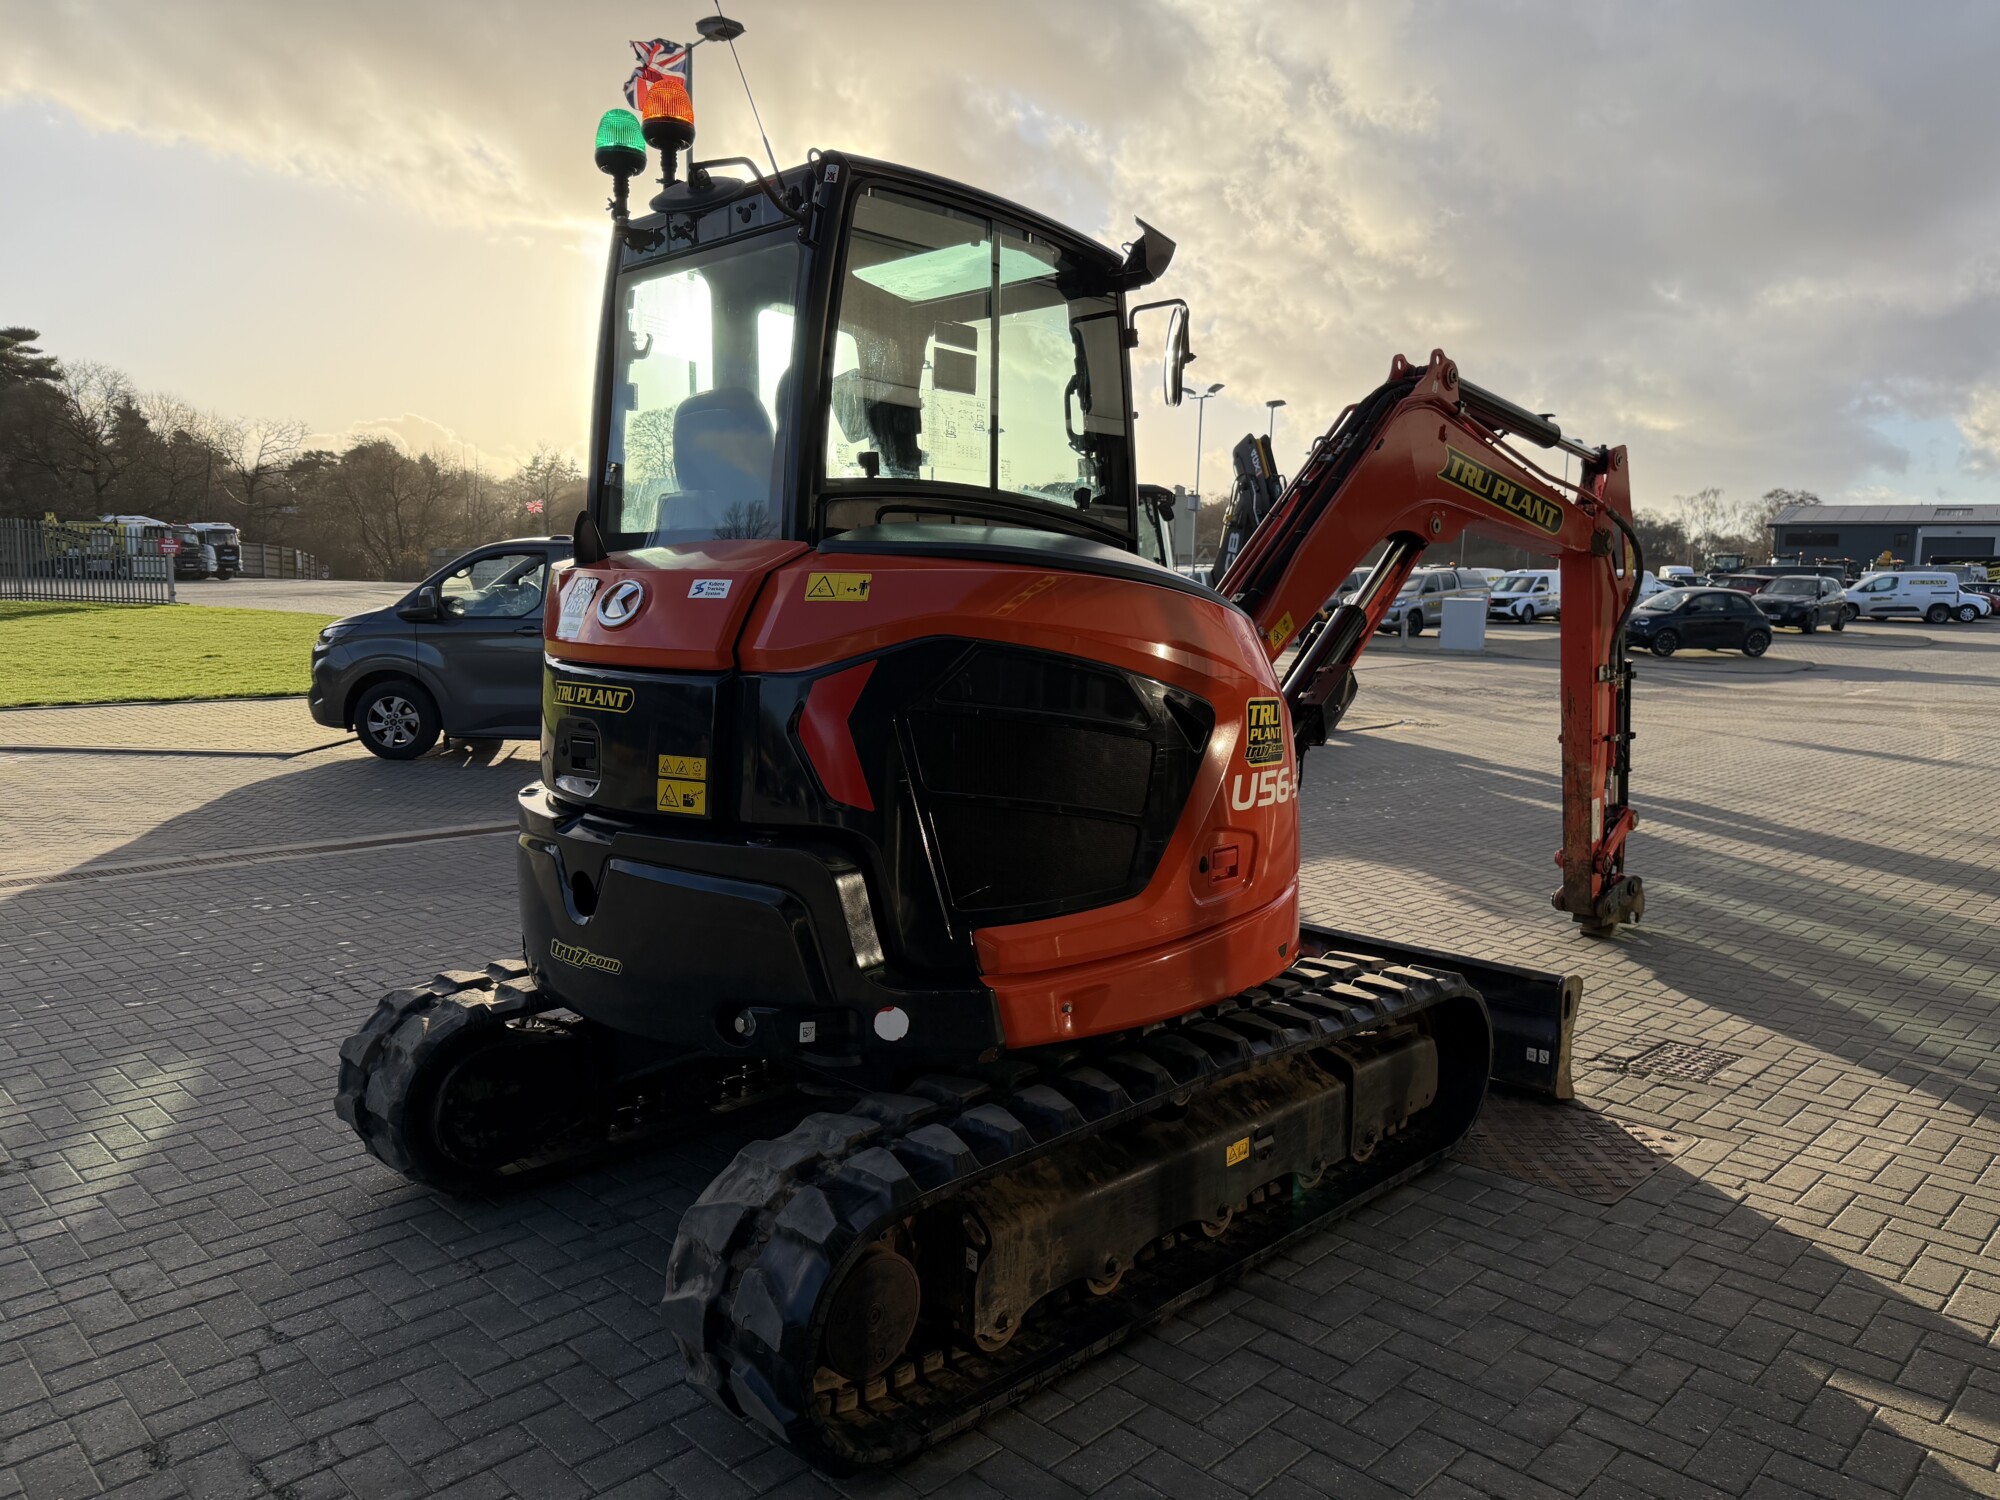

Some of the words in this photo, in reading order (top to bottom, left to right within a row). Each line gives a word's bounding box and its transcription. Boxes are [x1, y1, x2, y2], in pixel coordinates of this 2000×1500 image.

[1450, 455, 1492, 494] TRU
[1492, 479, 1559, 527] PLANT
[557, 685, 577, 702] TRU
[577, 687, 628, 708] PLANT
[1249, 704, 1280, 726] TRU
[1250, 727, 1281, 741] PLANT
[550, 938, 623, 975] tru7.com
